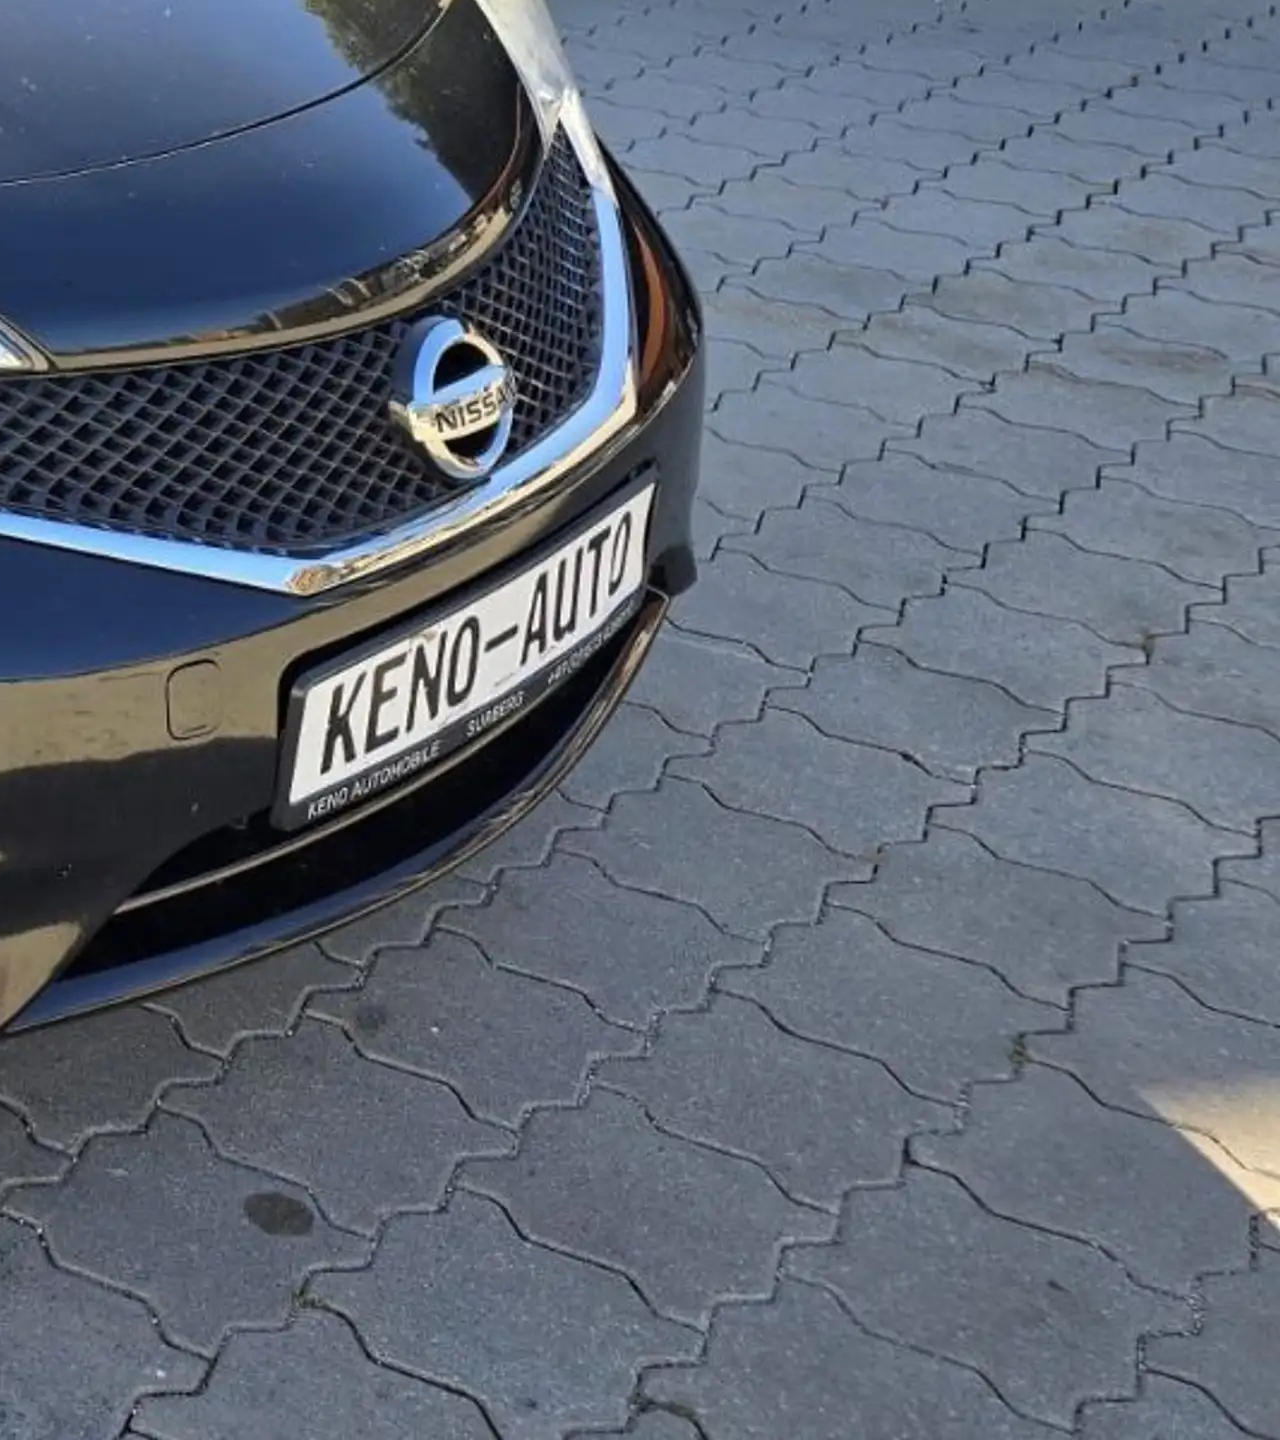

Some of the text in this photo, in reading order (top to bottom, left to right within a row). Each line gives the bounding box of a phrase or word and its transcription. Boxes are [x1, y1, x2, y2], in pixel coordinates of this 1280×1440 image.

[320, 510, 632, 776] KENO-AUTO
[308, 787, 348, 820] KENO
[349, 739, 440, 802] AUTOMOBILE
